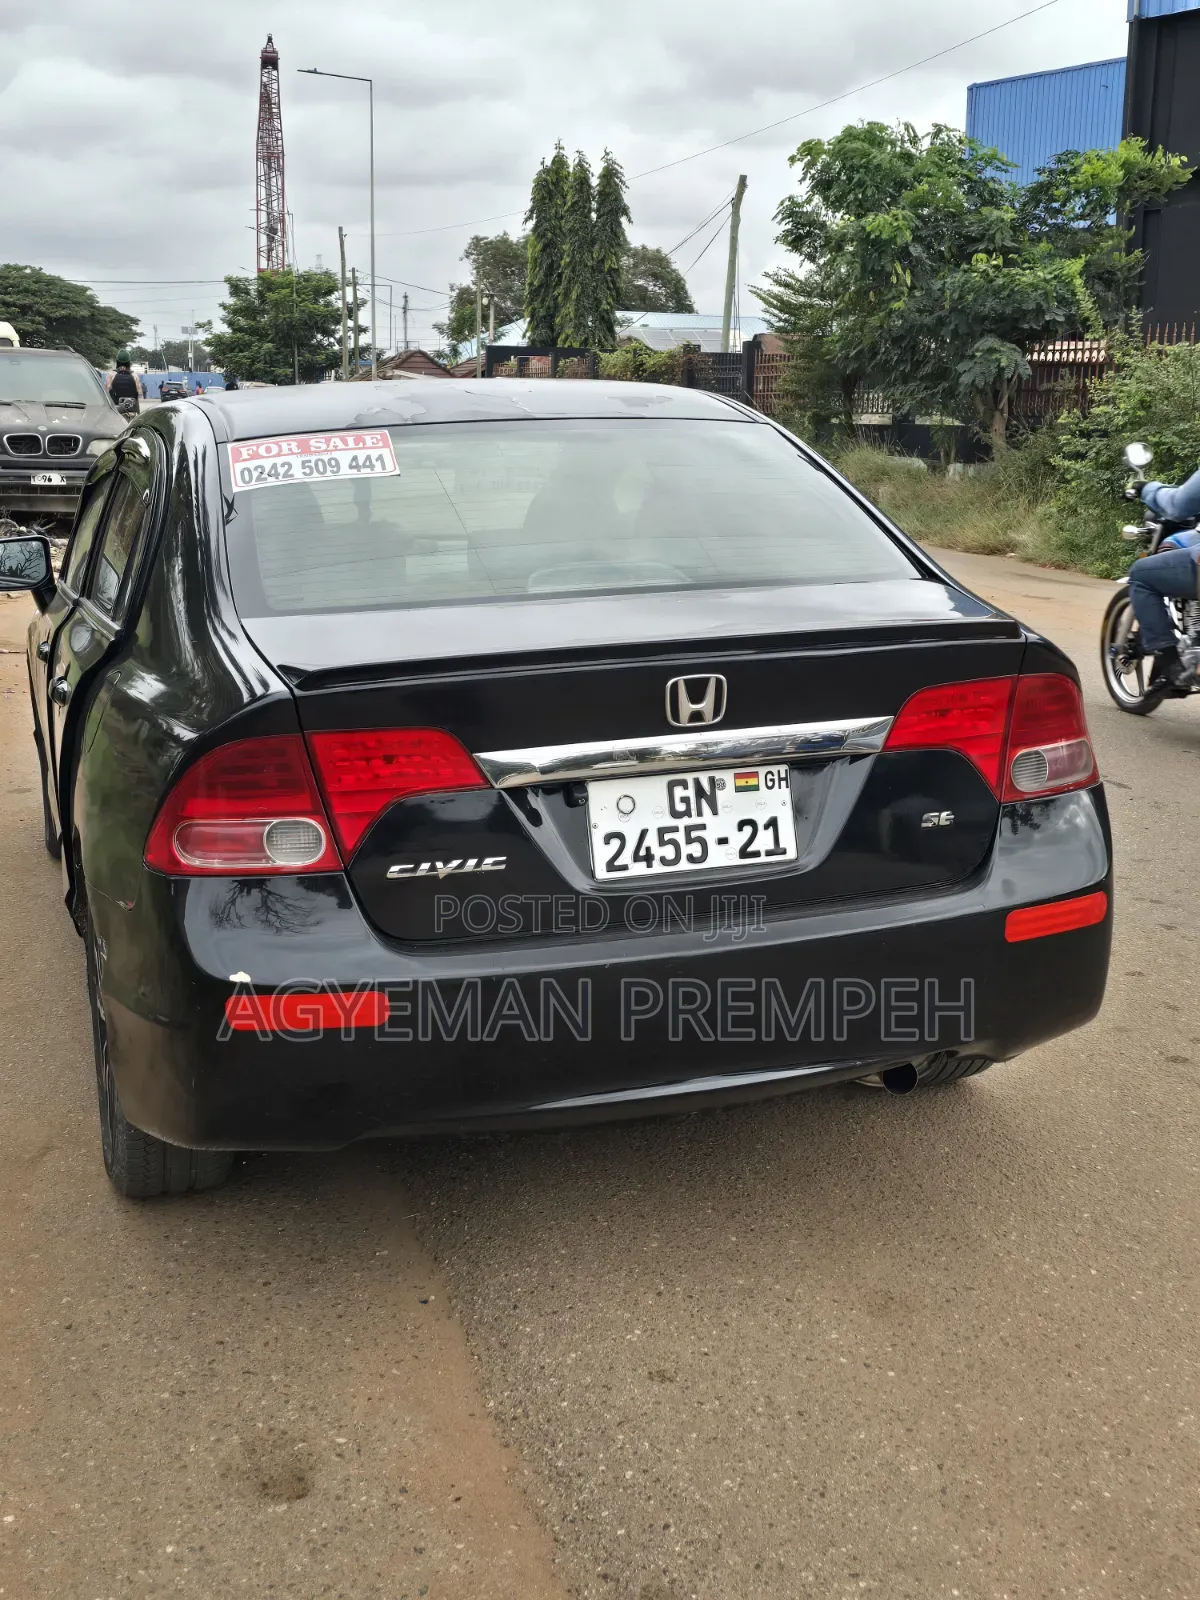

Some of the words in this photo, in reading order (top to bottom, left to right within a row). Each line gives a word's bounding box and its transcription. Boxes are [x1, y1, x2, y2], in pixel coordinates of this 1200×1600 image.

[239, 440, 302, 461] FOR
[310, 434, 384, 452] SALE
[239, 461, 295, 485] 0242
[301, 457, 342, 477] 509
[348, 453, 387, 473] 441
[764, 769, 790, 790] GH
[667, 775, 719, 820] GN
[603, 816, 788, 873] 2455-21
[386, 856, 507, 880] CIVIC
